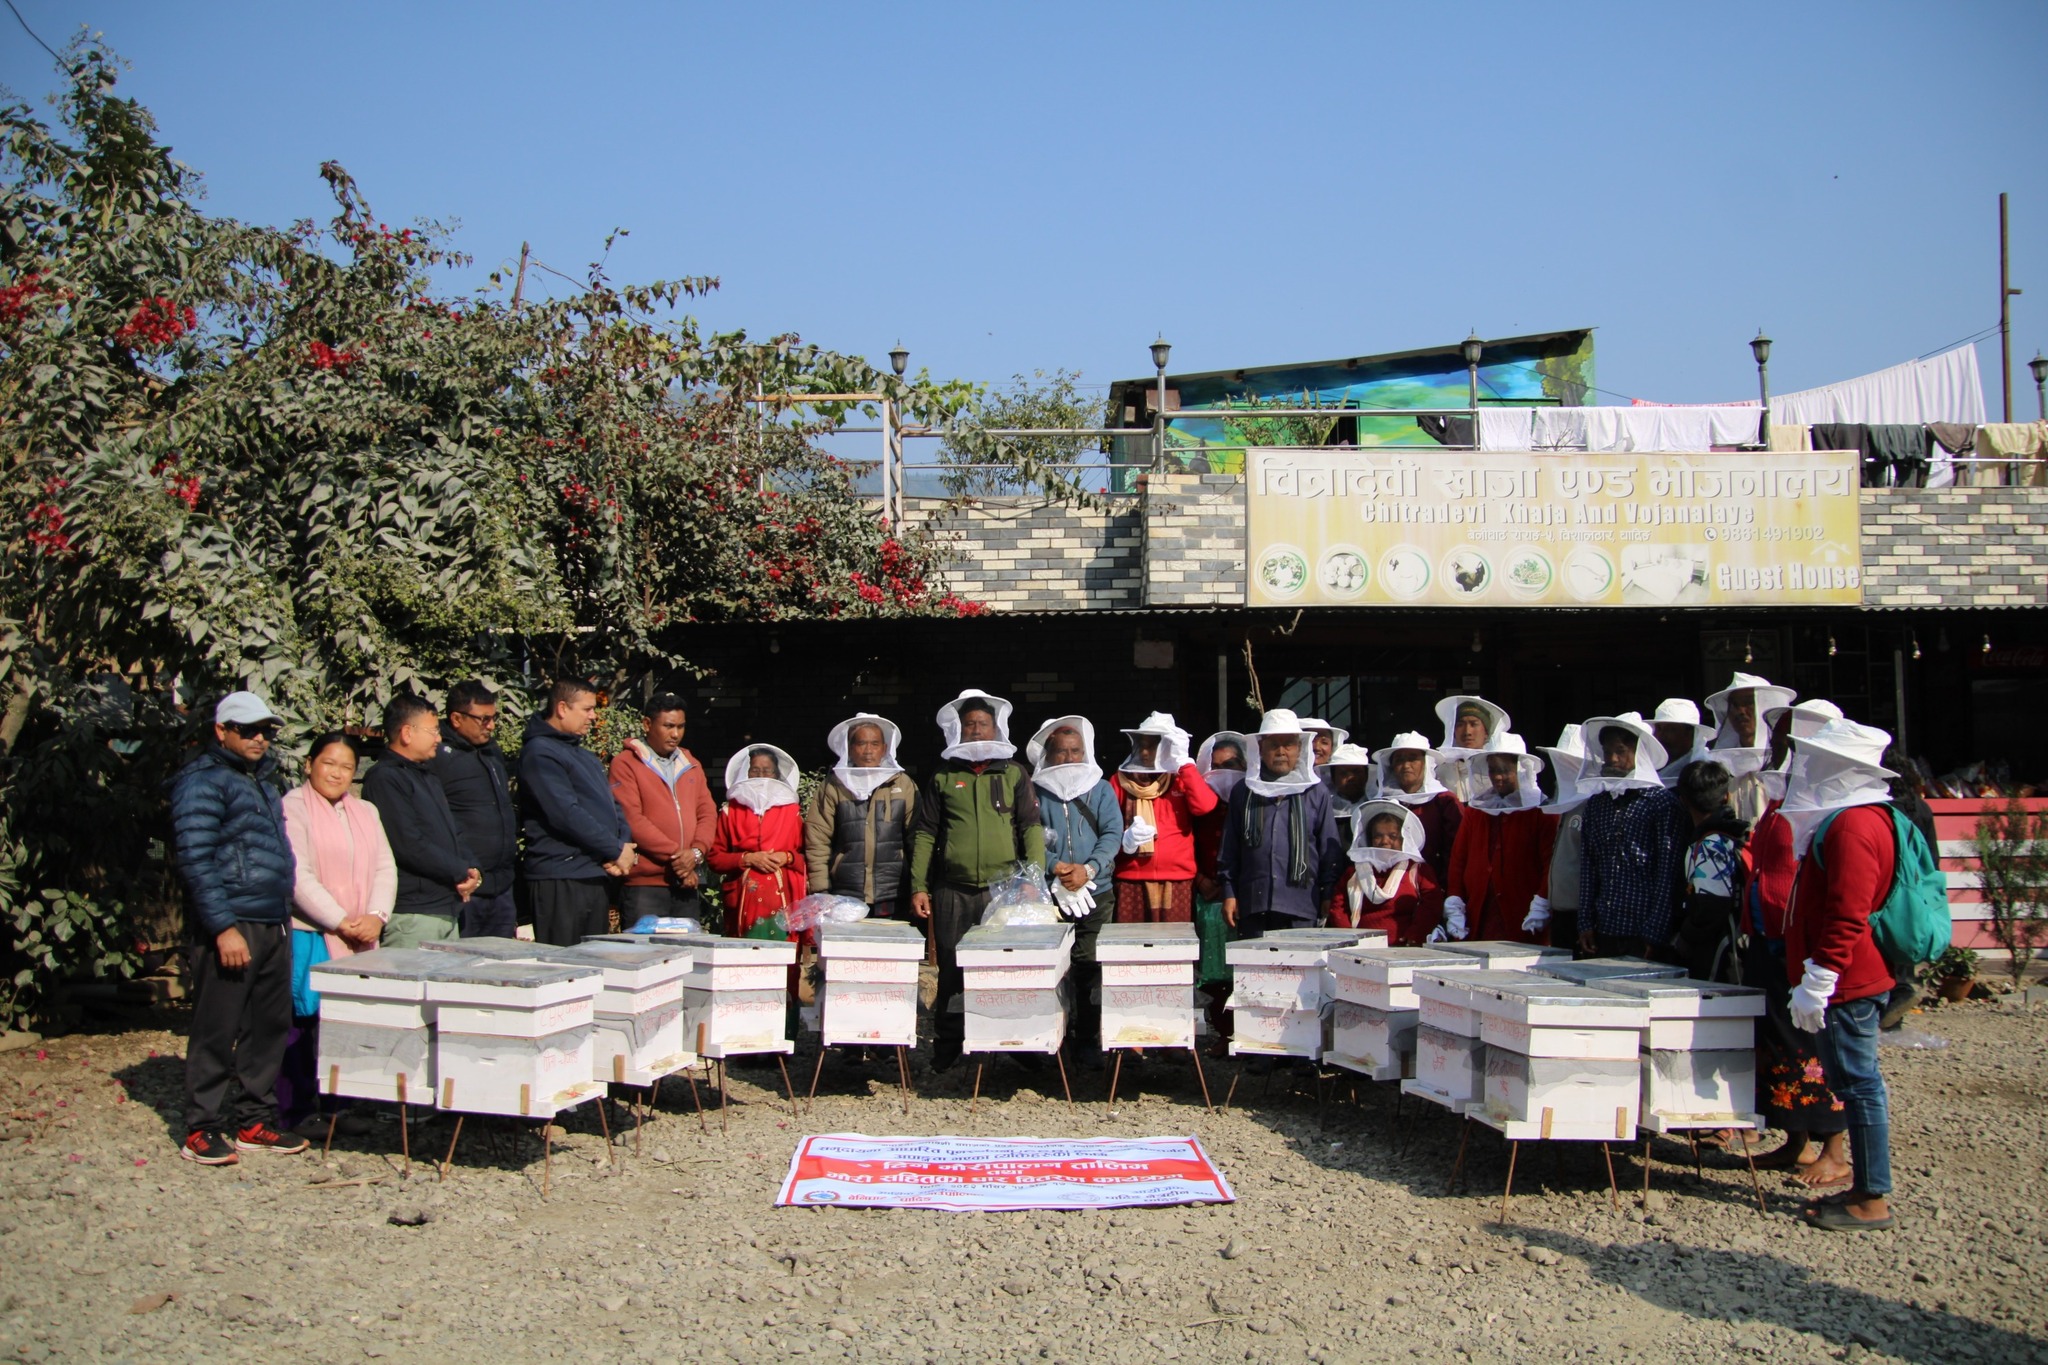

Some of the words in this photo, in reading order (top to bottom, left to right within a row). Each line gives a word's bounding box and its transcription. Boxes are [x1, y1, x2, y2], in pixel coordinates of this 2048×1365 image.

[1256, 456, 1421, 500] चित्रादेवी
[1432, 466, 1541, 499] खाजा
[1553, 466, 1638, 499] एण्ड
[1650, 458, 1854, 499] भोजनालय
[1361, 502, 1487, 524] Chitradevi
[1503, 503, 1568, 526] Khaja
[1576, 503, 1617, 524] And
[1624, 503, 1755, 526] Vojanalaye
[1716, 562, 1784, 591] Guest
[1788, 562, 1862, 591] House
